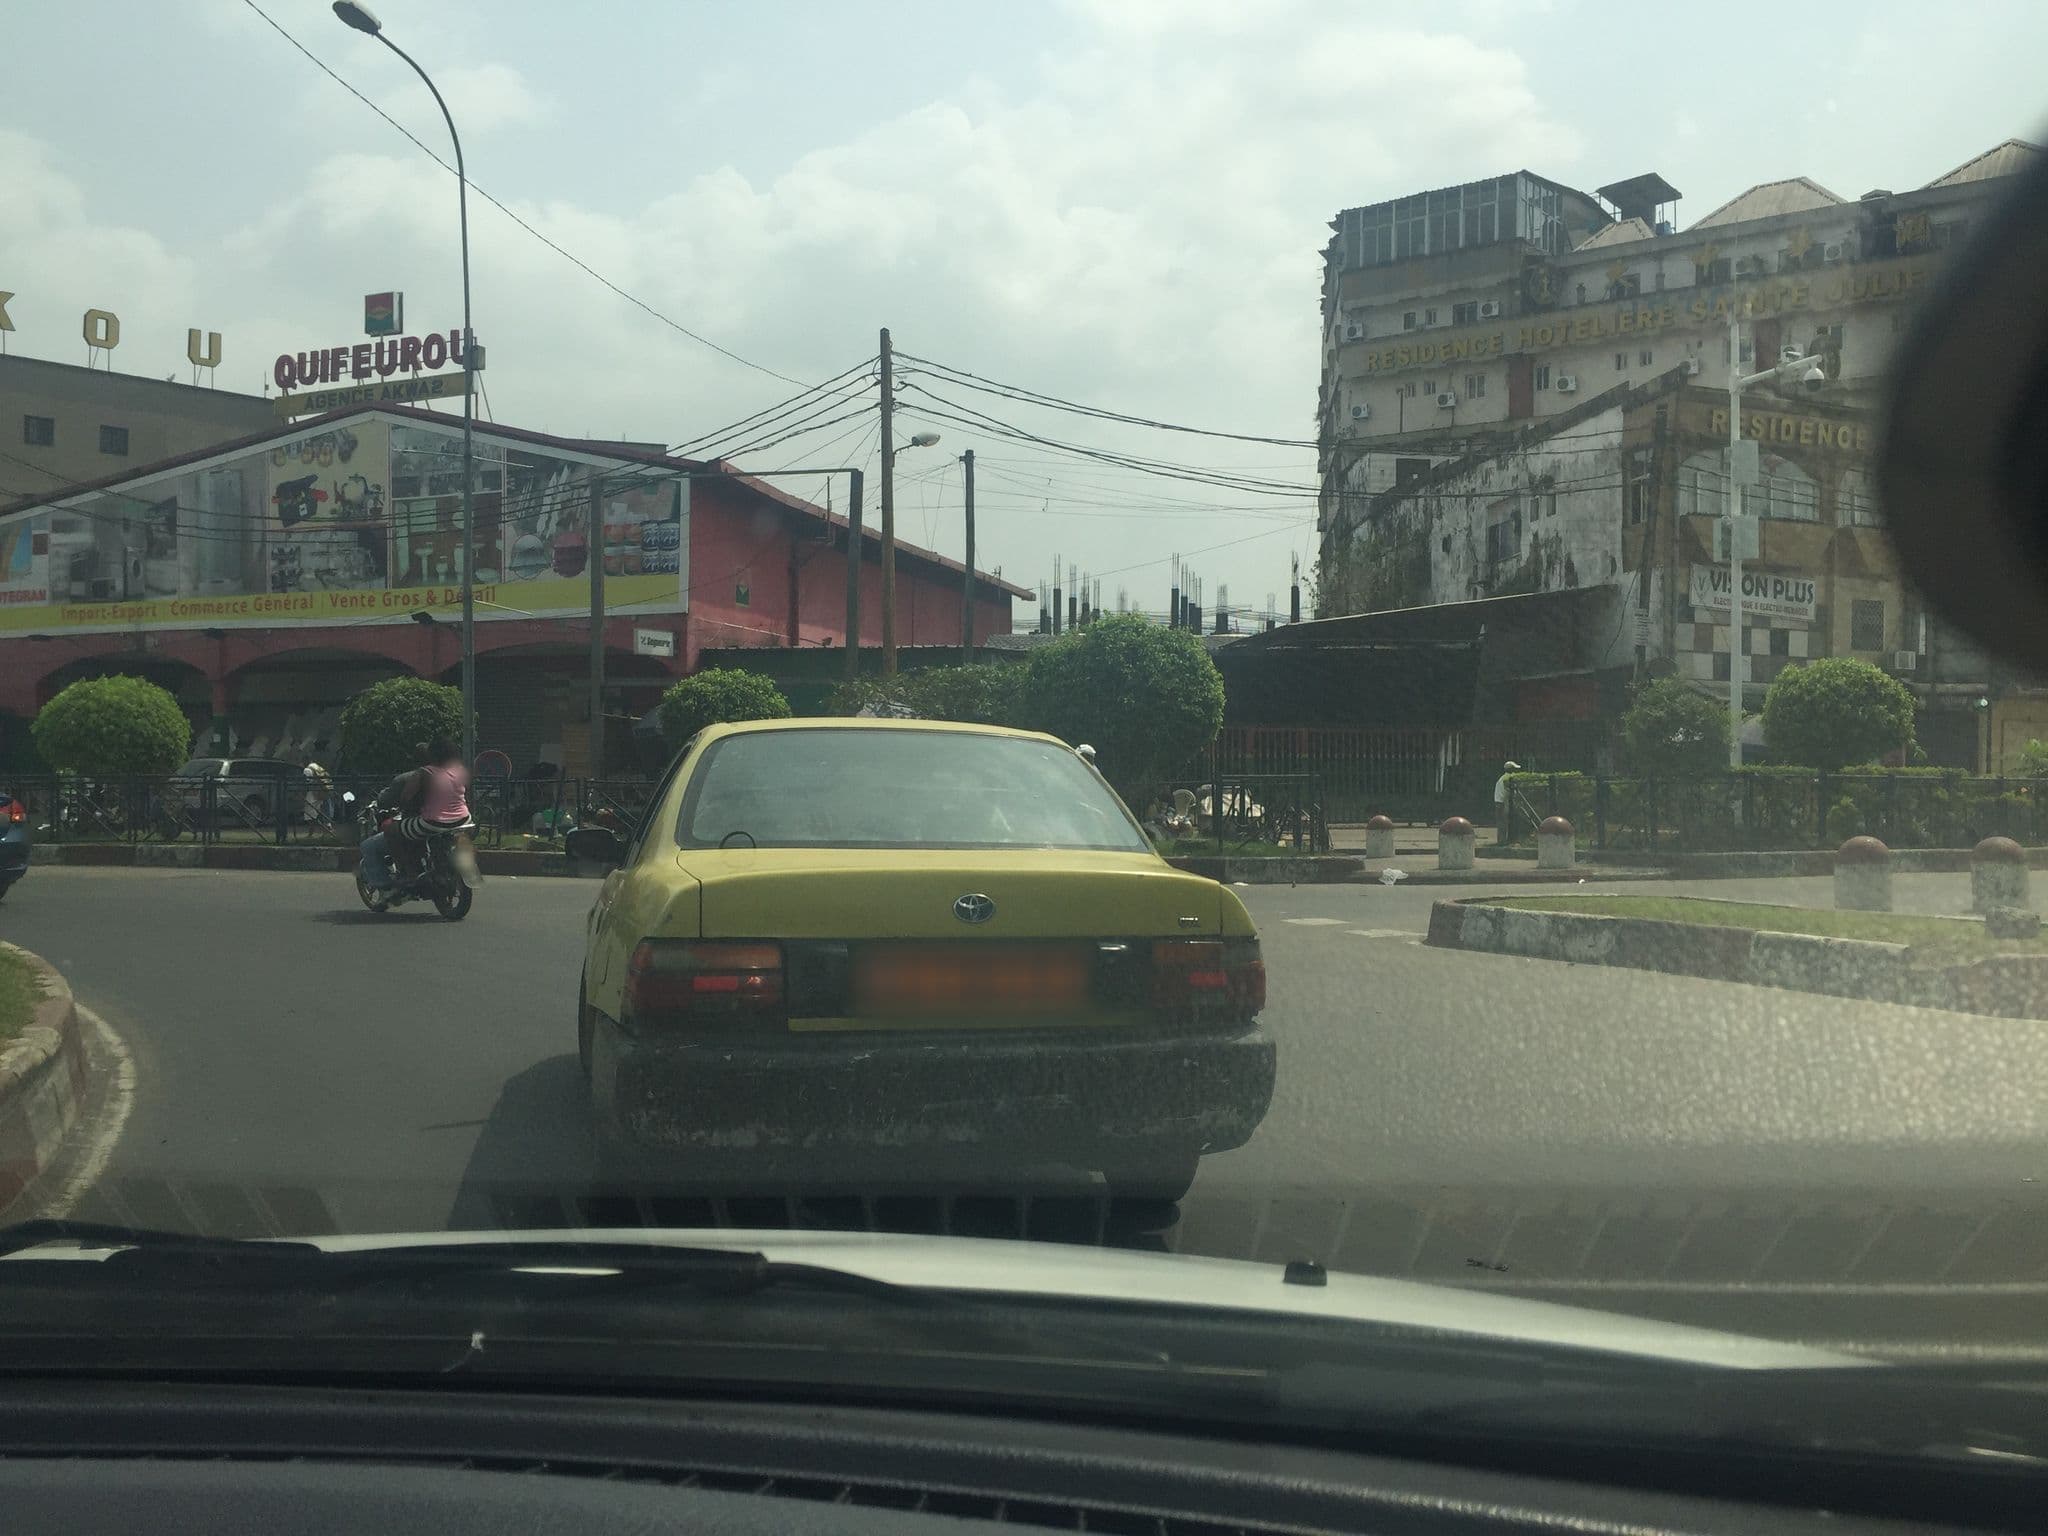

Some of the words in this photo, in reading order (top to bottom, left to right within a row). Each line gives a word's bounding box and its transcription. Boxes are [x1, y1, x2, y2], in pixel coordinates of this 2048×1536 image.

[1366, 335, 1501, 371] RESIDENCE
[1519, 307, 1674, 346] HOTELIERE
[304, 388, 374, 410] AGENCE
[1712, 408, 1869, 450] RSIDENCE
[61, 605, 157, 623] Import-Export
[169, 600, 248, 617] Commerce
[253, 594, 314, 613] Général
[382, 591, 420, 607] Gros
[426, 590, 439, 606] &
[444, 586, 496, 604] Déail
[1710, 569, 1768, 598] VION
[1773, 579, 1814, 604] PLUS
